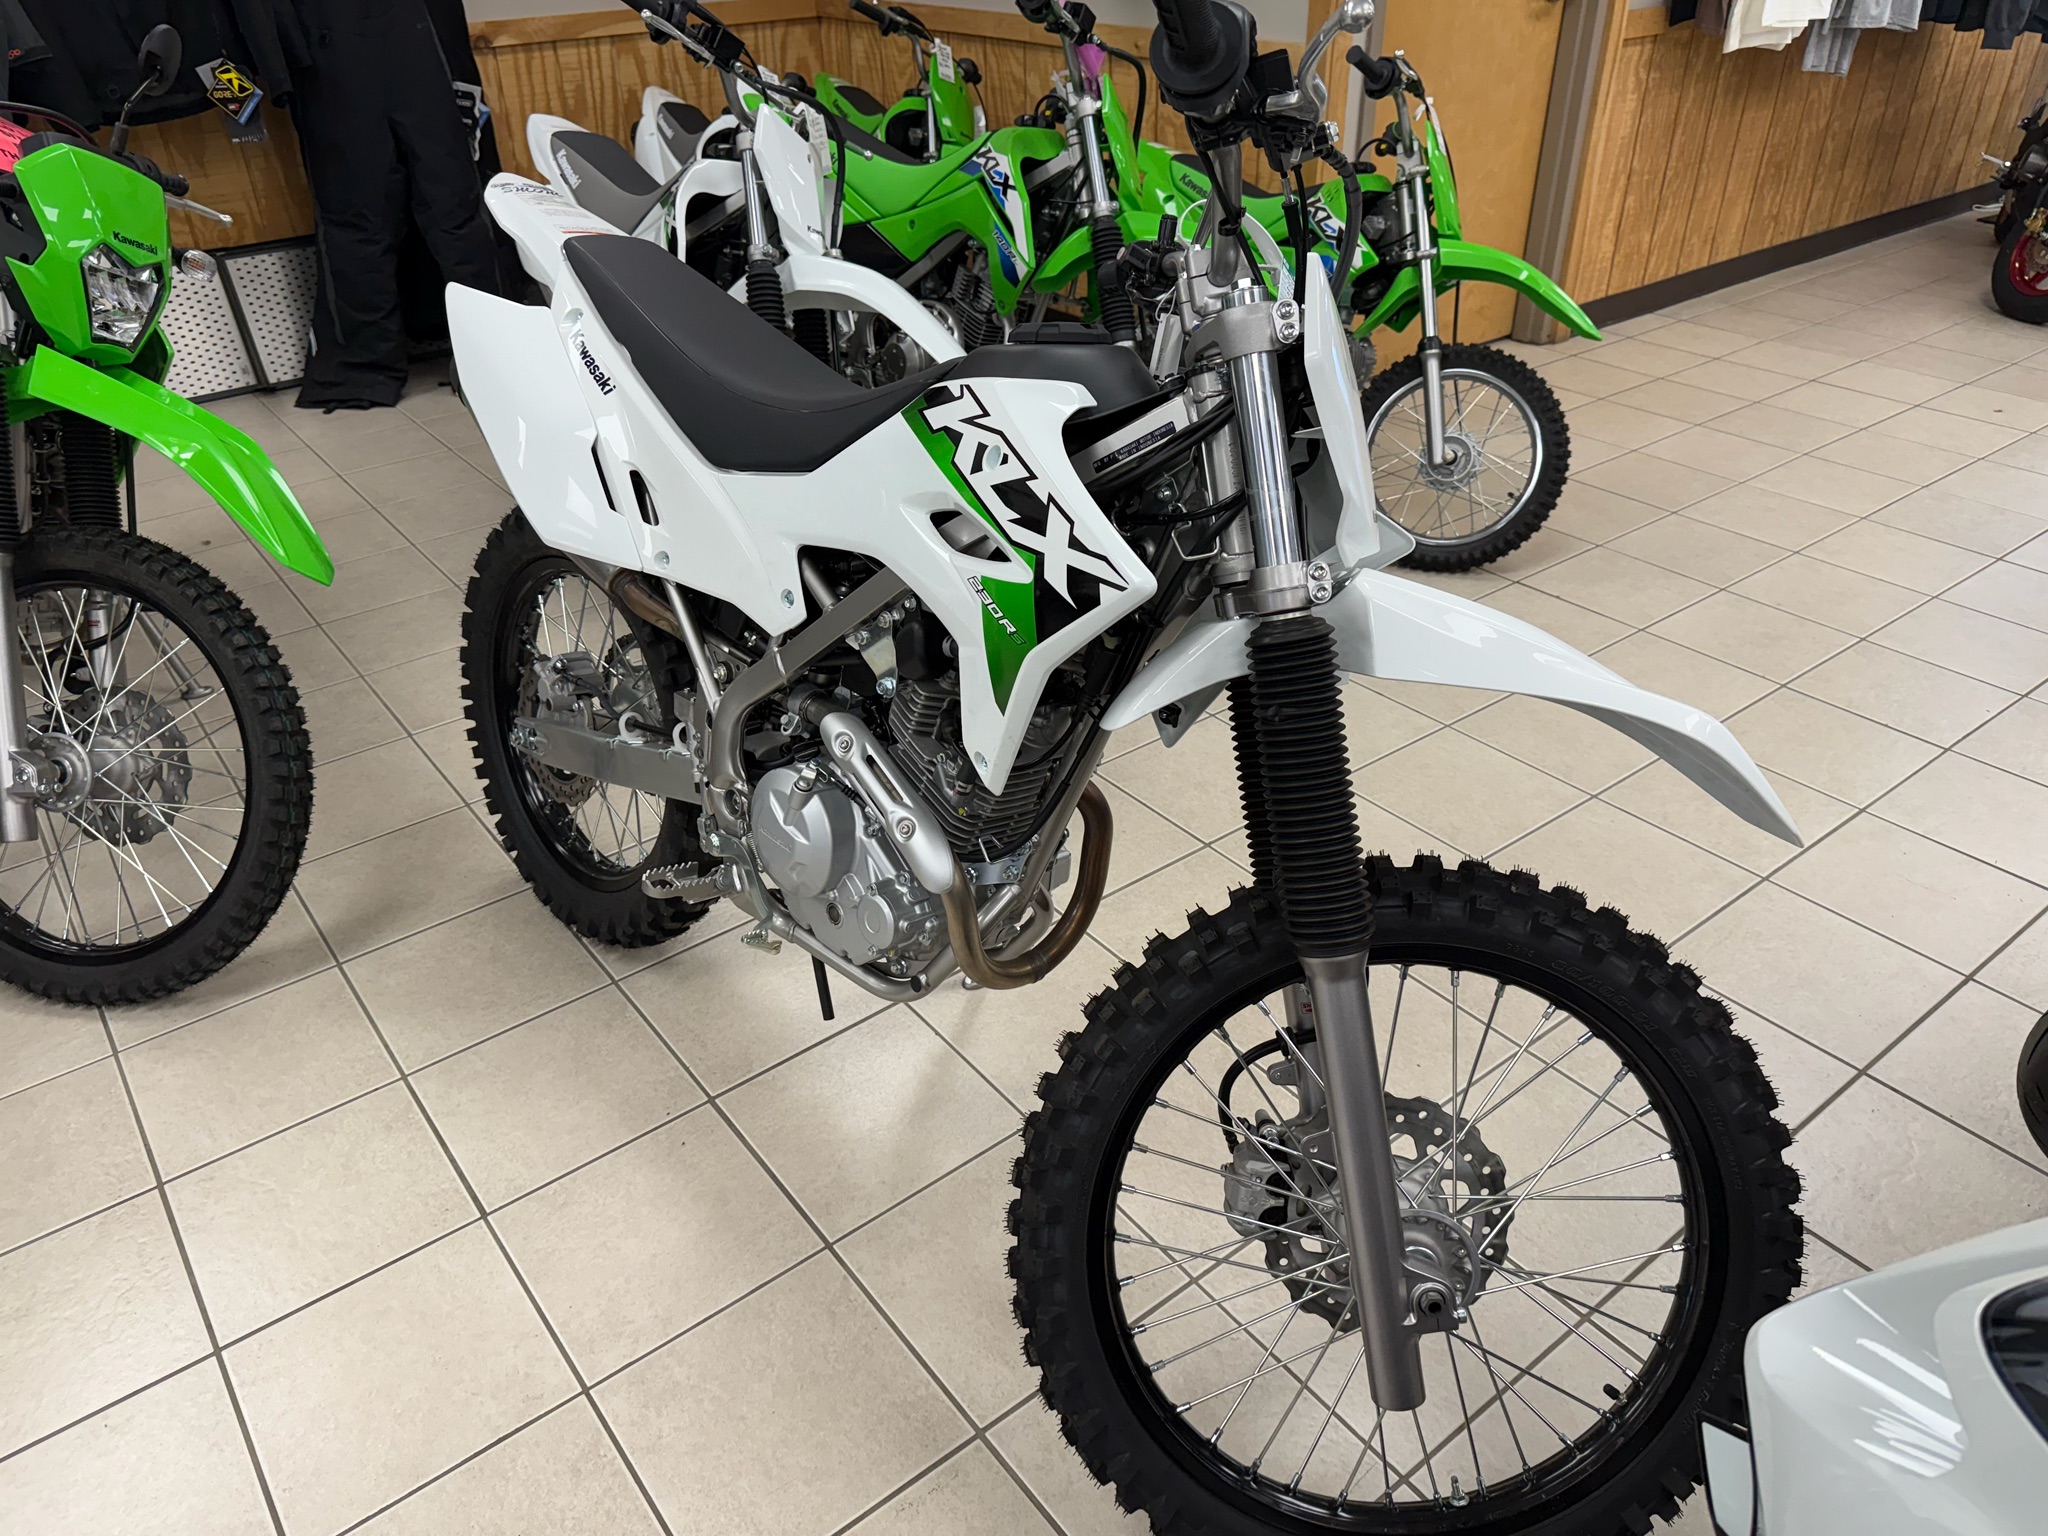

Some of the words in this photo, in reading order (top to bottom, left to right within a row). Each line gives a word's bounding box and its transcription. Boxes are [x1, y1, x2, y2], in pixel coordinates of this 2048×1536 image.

[976, 147, 1018, 200] KLX
[1178, 173, 1208, 200] Kawas
[112, 230, 158, 256] Kawasaki
[569, 328, 617, 396] Kawasaki
[1138, 435, 1161, 450] INDONESIA
[1153, 422, 1174, 437] INDONESIA
[919, 384, 1134, 610] KLX
